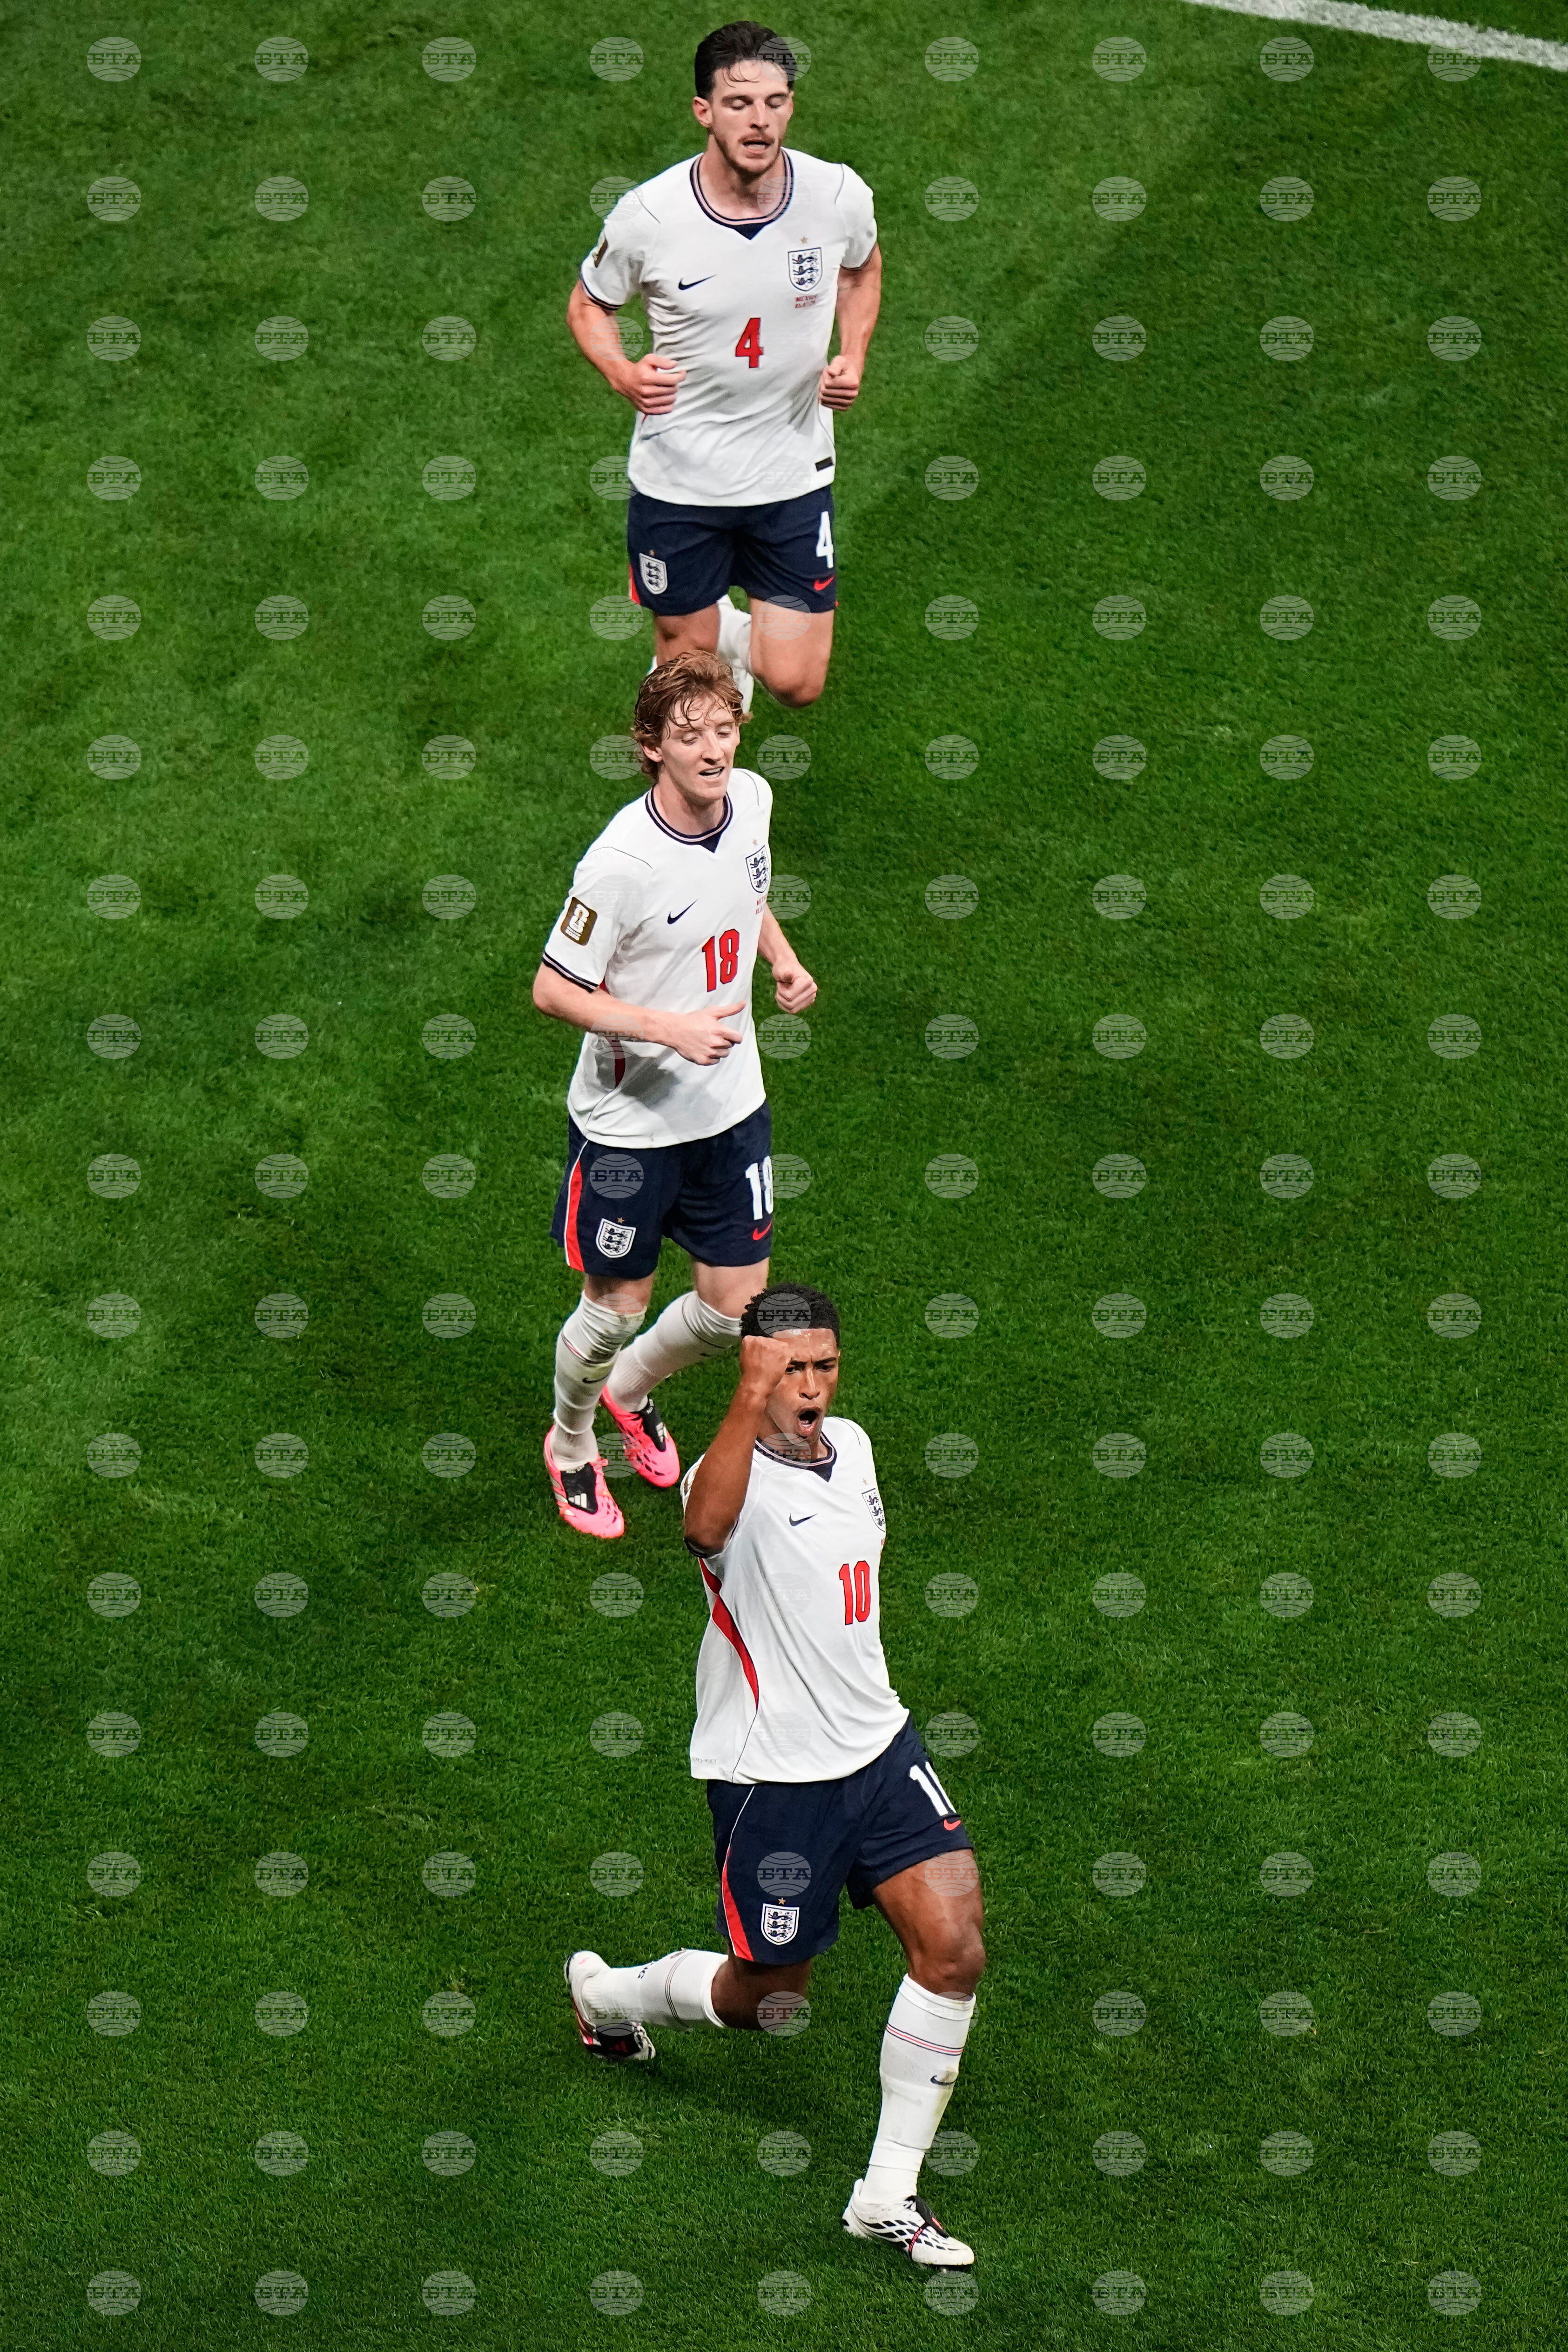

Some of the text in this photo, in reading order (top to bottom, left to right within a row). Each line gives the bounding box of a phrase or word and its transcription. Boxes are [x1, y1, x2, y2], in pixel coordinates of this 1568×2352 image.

[735, 317, 764, 368] 4
[816, 511, 834, 569] 4
[702, 928, 740, 992] 18
[838, 1560, 871, 1626] 10
